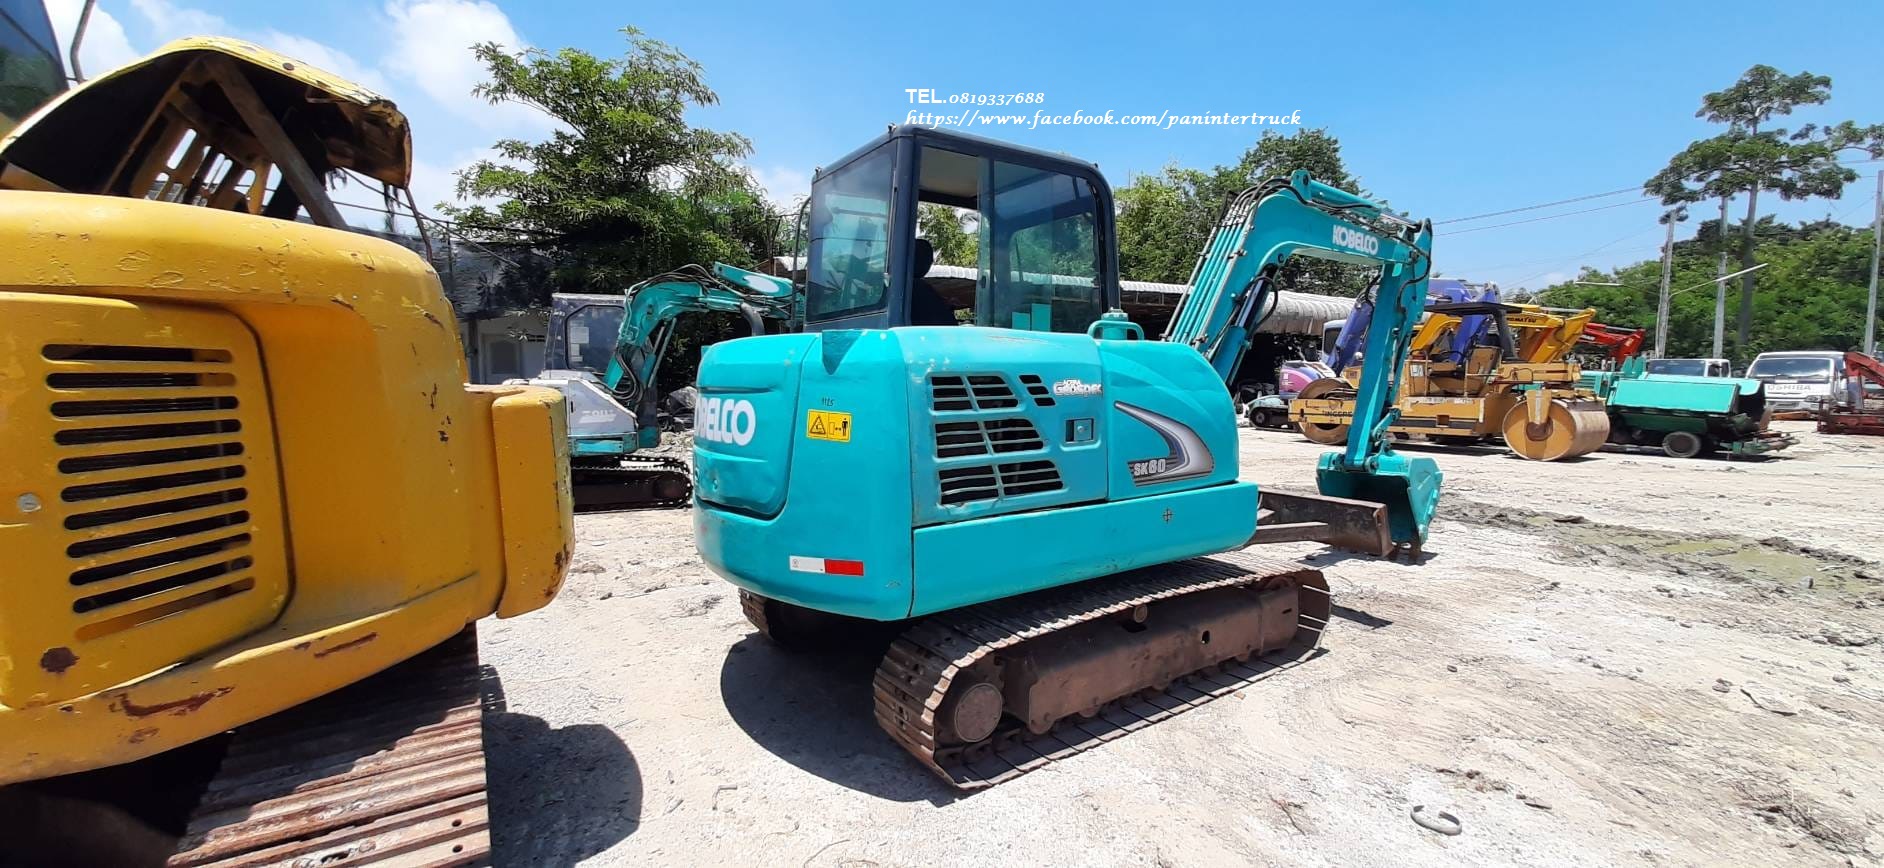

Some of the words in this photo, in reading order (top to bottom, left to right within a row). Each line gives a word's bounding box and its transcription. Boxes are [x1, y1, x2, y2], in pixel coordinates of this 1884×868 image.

[1332, 224, 1379, 255] KOBELCO
[694, 397, 757, 446] OBELCO
[1133, 459, 1166, 476] SK60
